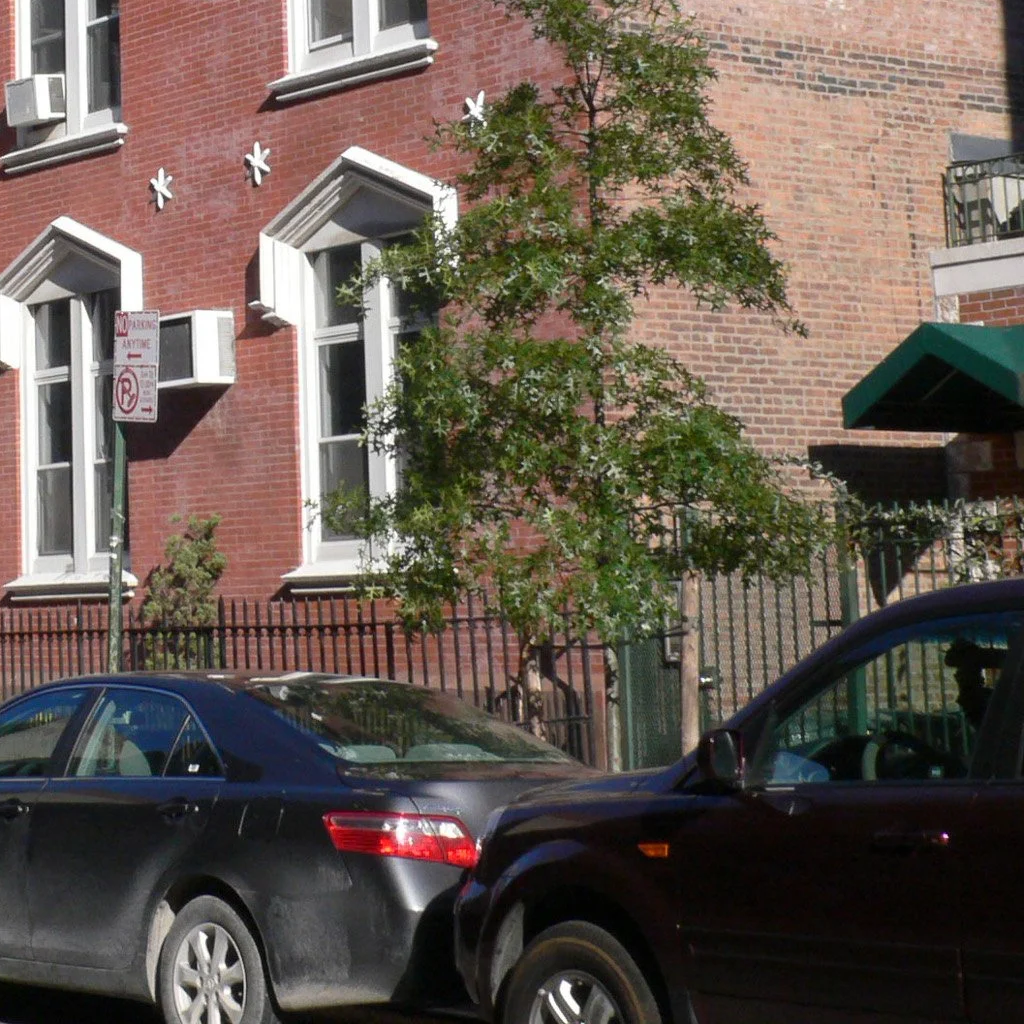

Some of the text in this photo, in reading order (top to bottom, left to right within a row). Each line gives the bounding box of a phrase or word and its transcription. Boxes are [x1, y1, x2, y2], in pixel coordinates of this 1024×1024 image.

[116, 313, 156, 336] NO PARKING
[122, 338, 152, 350] ANYTIME
